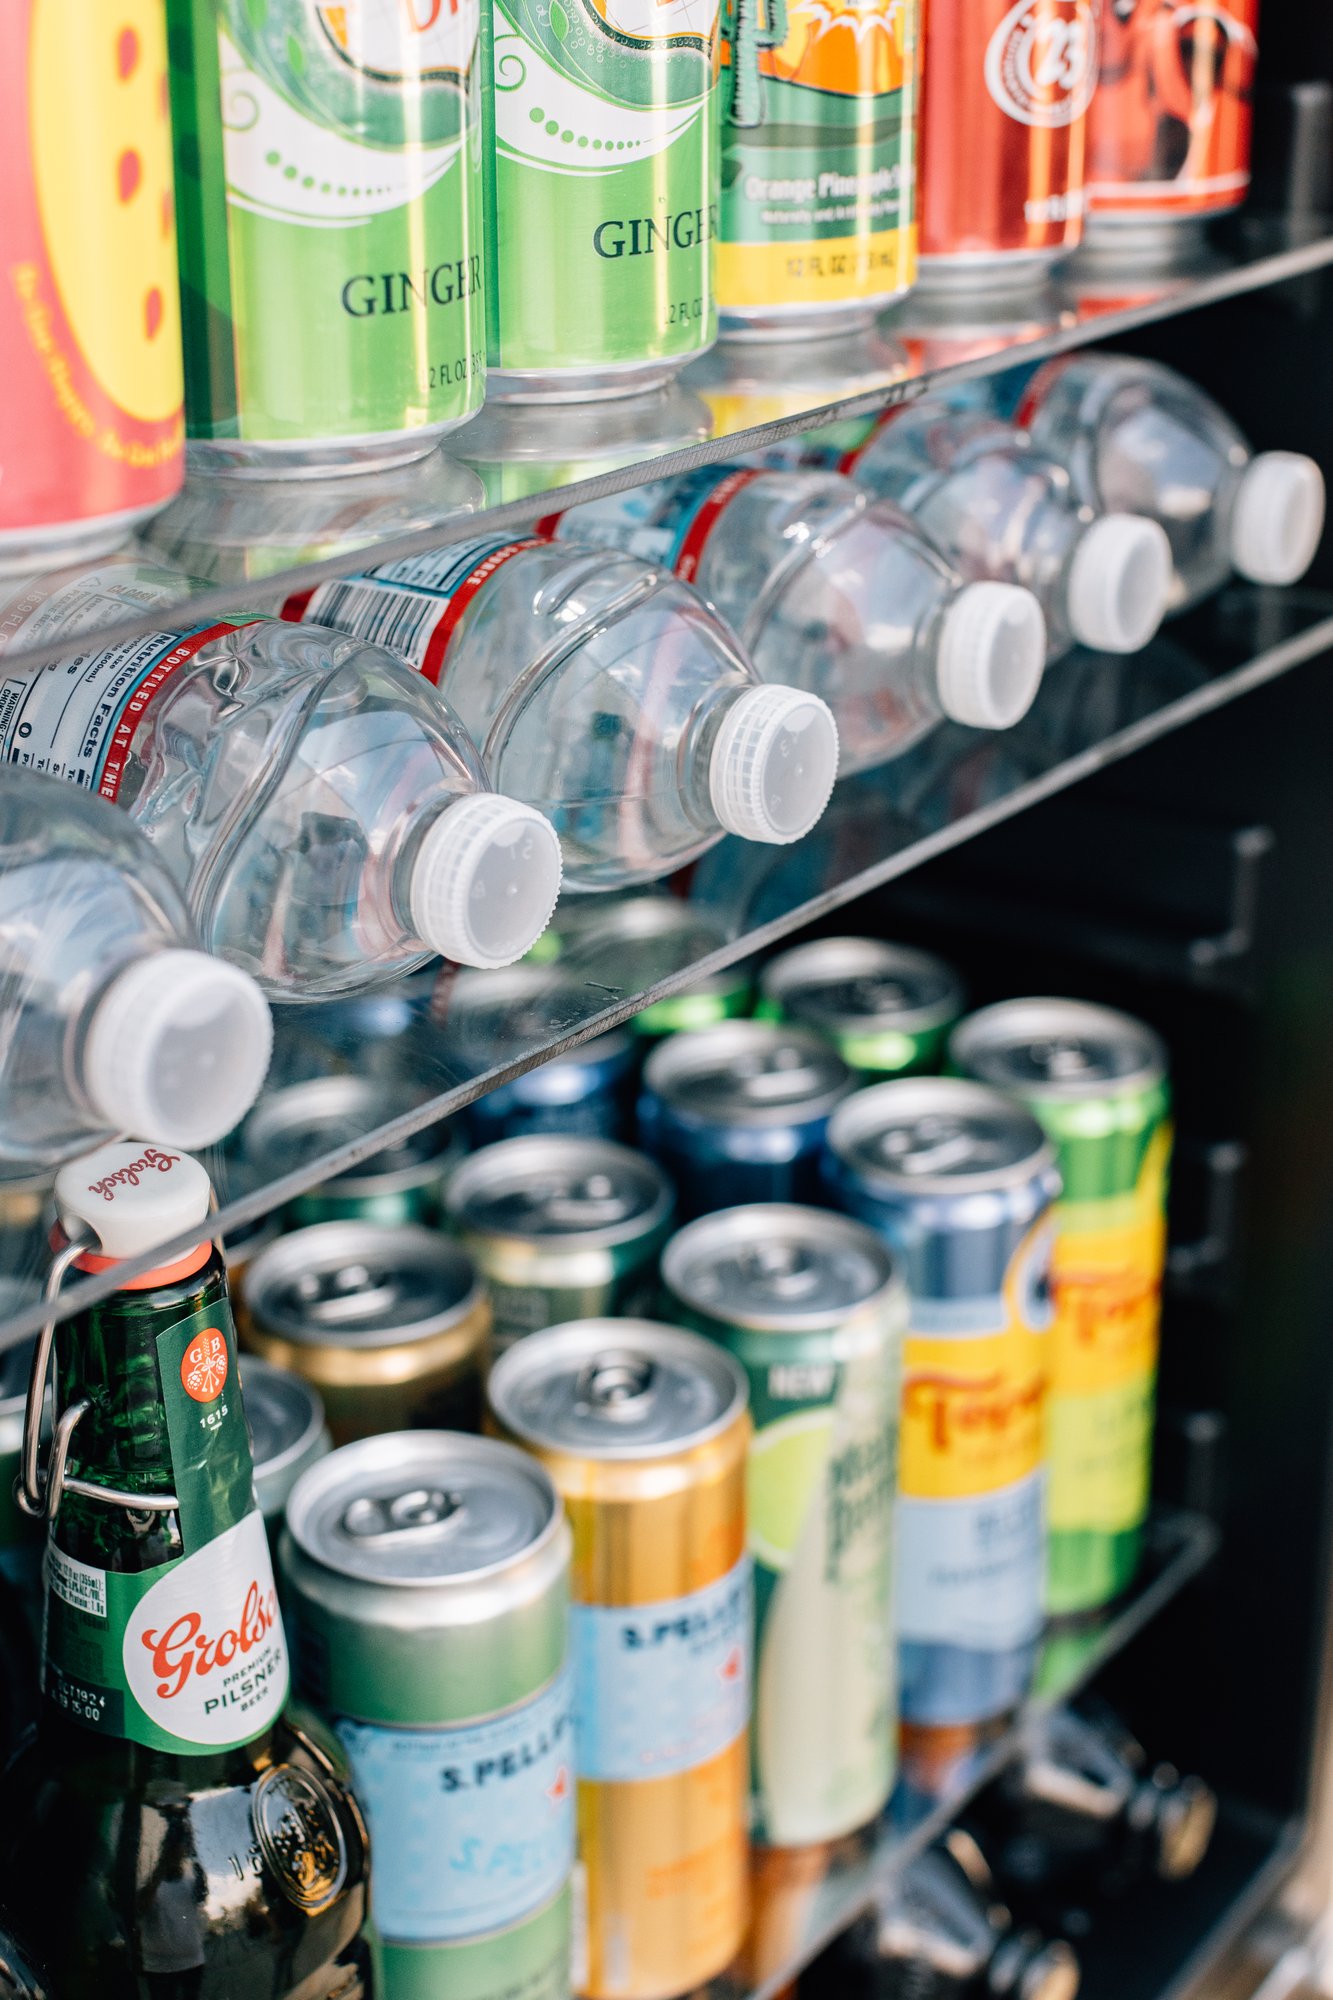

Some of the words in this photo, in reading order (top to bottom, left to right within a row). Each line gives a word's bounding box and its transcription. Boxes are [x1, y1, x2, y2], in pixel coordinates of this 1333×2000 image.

[744, 174, 816, 204] Orange
[341, 254, 482, 318] GINGER
[106, 633, 173, 699] Nutrition
[129, 647, 191, 712] BOTTLED
[83, 702, 113, 759] Facts
[113, 723, 132, 748] AT
[101, 762, 120, 797] THE
[88, 1148, 181, 1202] Grolsch
[200, 1406, 229, 1430] 1615
[204, 1647, 284, 1716] PILSNER
[223, 1645, 272, 1688] PREMIUM
[240, 1686, 270, 1713] BEER
